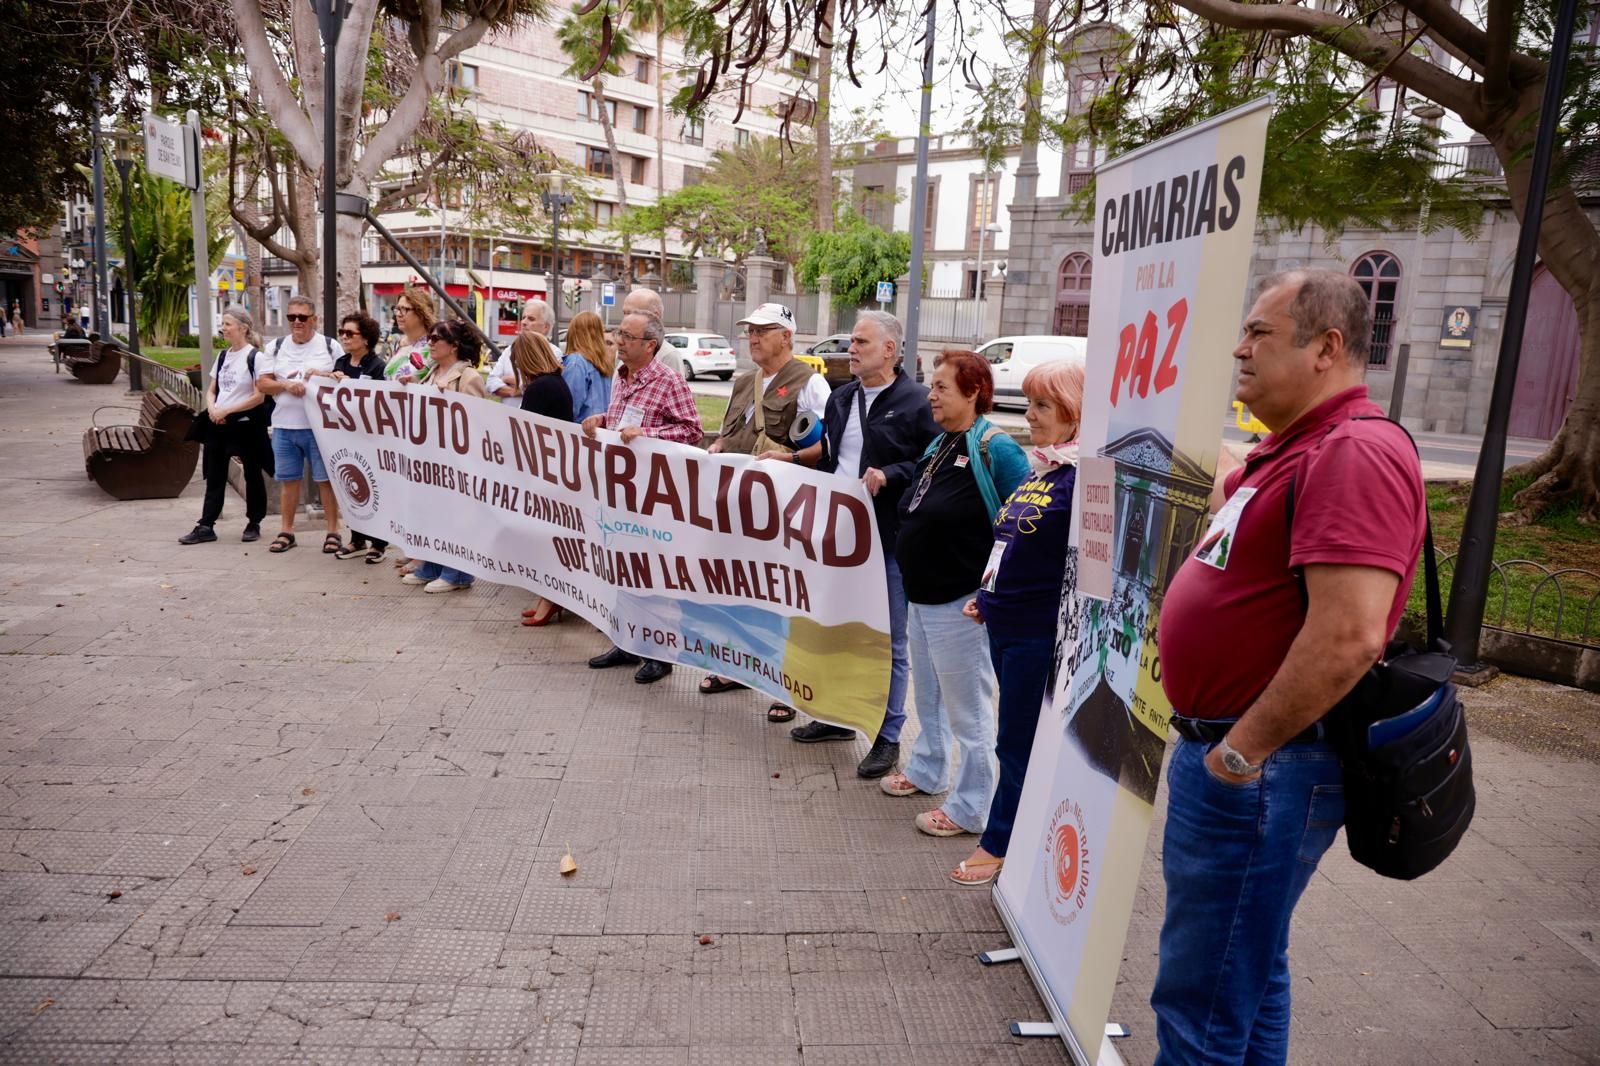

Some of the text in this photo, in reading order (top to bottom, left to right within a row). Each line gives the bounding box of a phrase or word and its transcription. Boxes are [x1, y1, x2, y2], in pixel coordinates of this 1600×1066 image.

[1101, 155, 1245, 257] CANARIAS
[497, 290, 518, 300] GAES
[1136, 260, 1175, 292] POR LA
[1110, 297, 1188, 408] PAZ
[316, 386, 872, 567] ESTATUTO de NEUTRALIDAD
[354, 451, 380, 513] NEUTRALIDAD
[377, 448, 397, 473] LOS
[457, 470, 471, 496] DE
[473, 475, 487, 503] LA
[492, 481, 519, 512] PAZ
[524, 490, 585, 535] CANARIA
[1086, 484, 1110, 504] ESTATUTO
[614, 521, 673, 542] OTAN NO
[1082, 511, 1113, 534] NEUTRALIDAD
[552, 536, 811, 613] QUE COJAN LA MALETA
[433, 538, 475, 563] CANARIA
[476, 553, 496, 571] POR
[498, 560, 516, 574] LA
[544, 574, 585, 604] CONTRA
[587, 594, 599, 613] LA
[627, 622, 636, 638] Y
[643, 627, 677, 649] POR
[684, 636, 705, 654] LA
[710, 642, 814, 701] NEUTRALIDAD
[1110, 628, 1132, 658] NO
[1140, 653, 1149, 671] LA
[1045, 798, 1070, 853] ESTATUTO
[1073, 801, 1090, 909] NEUTRALIDAD
